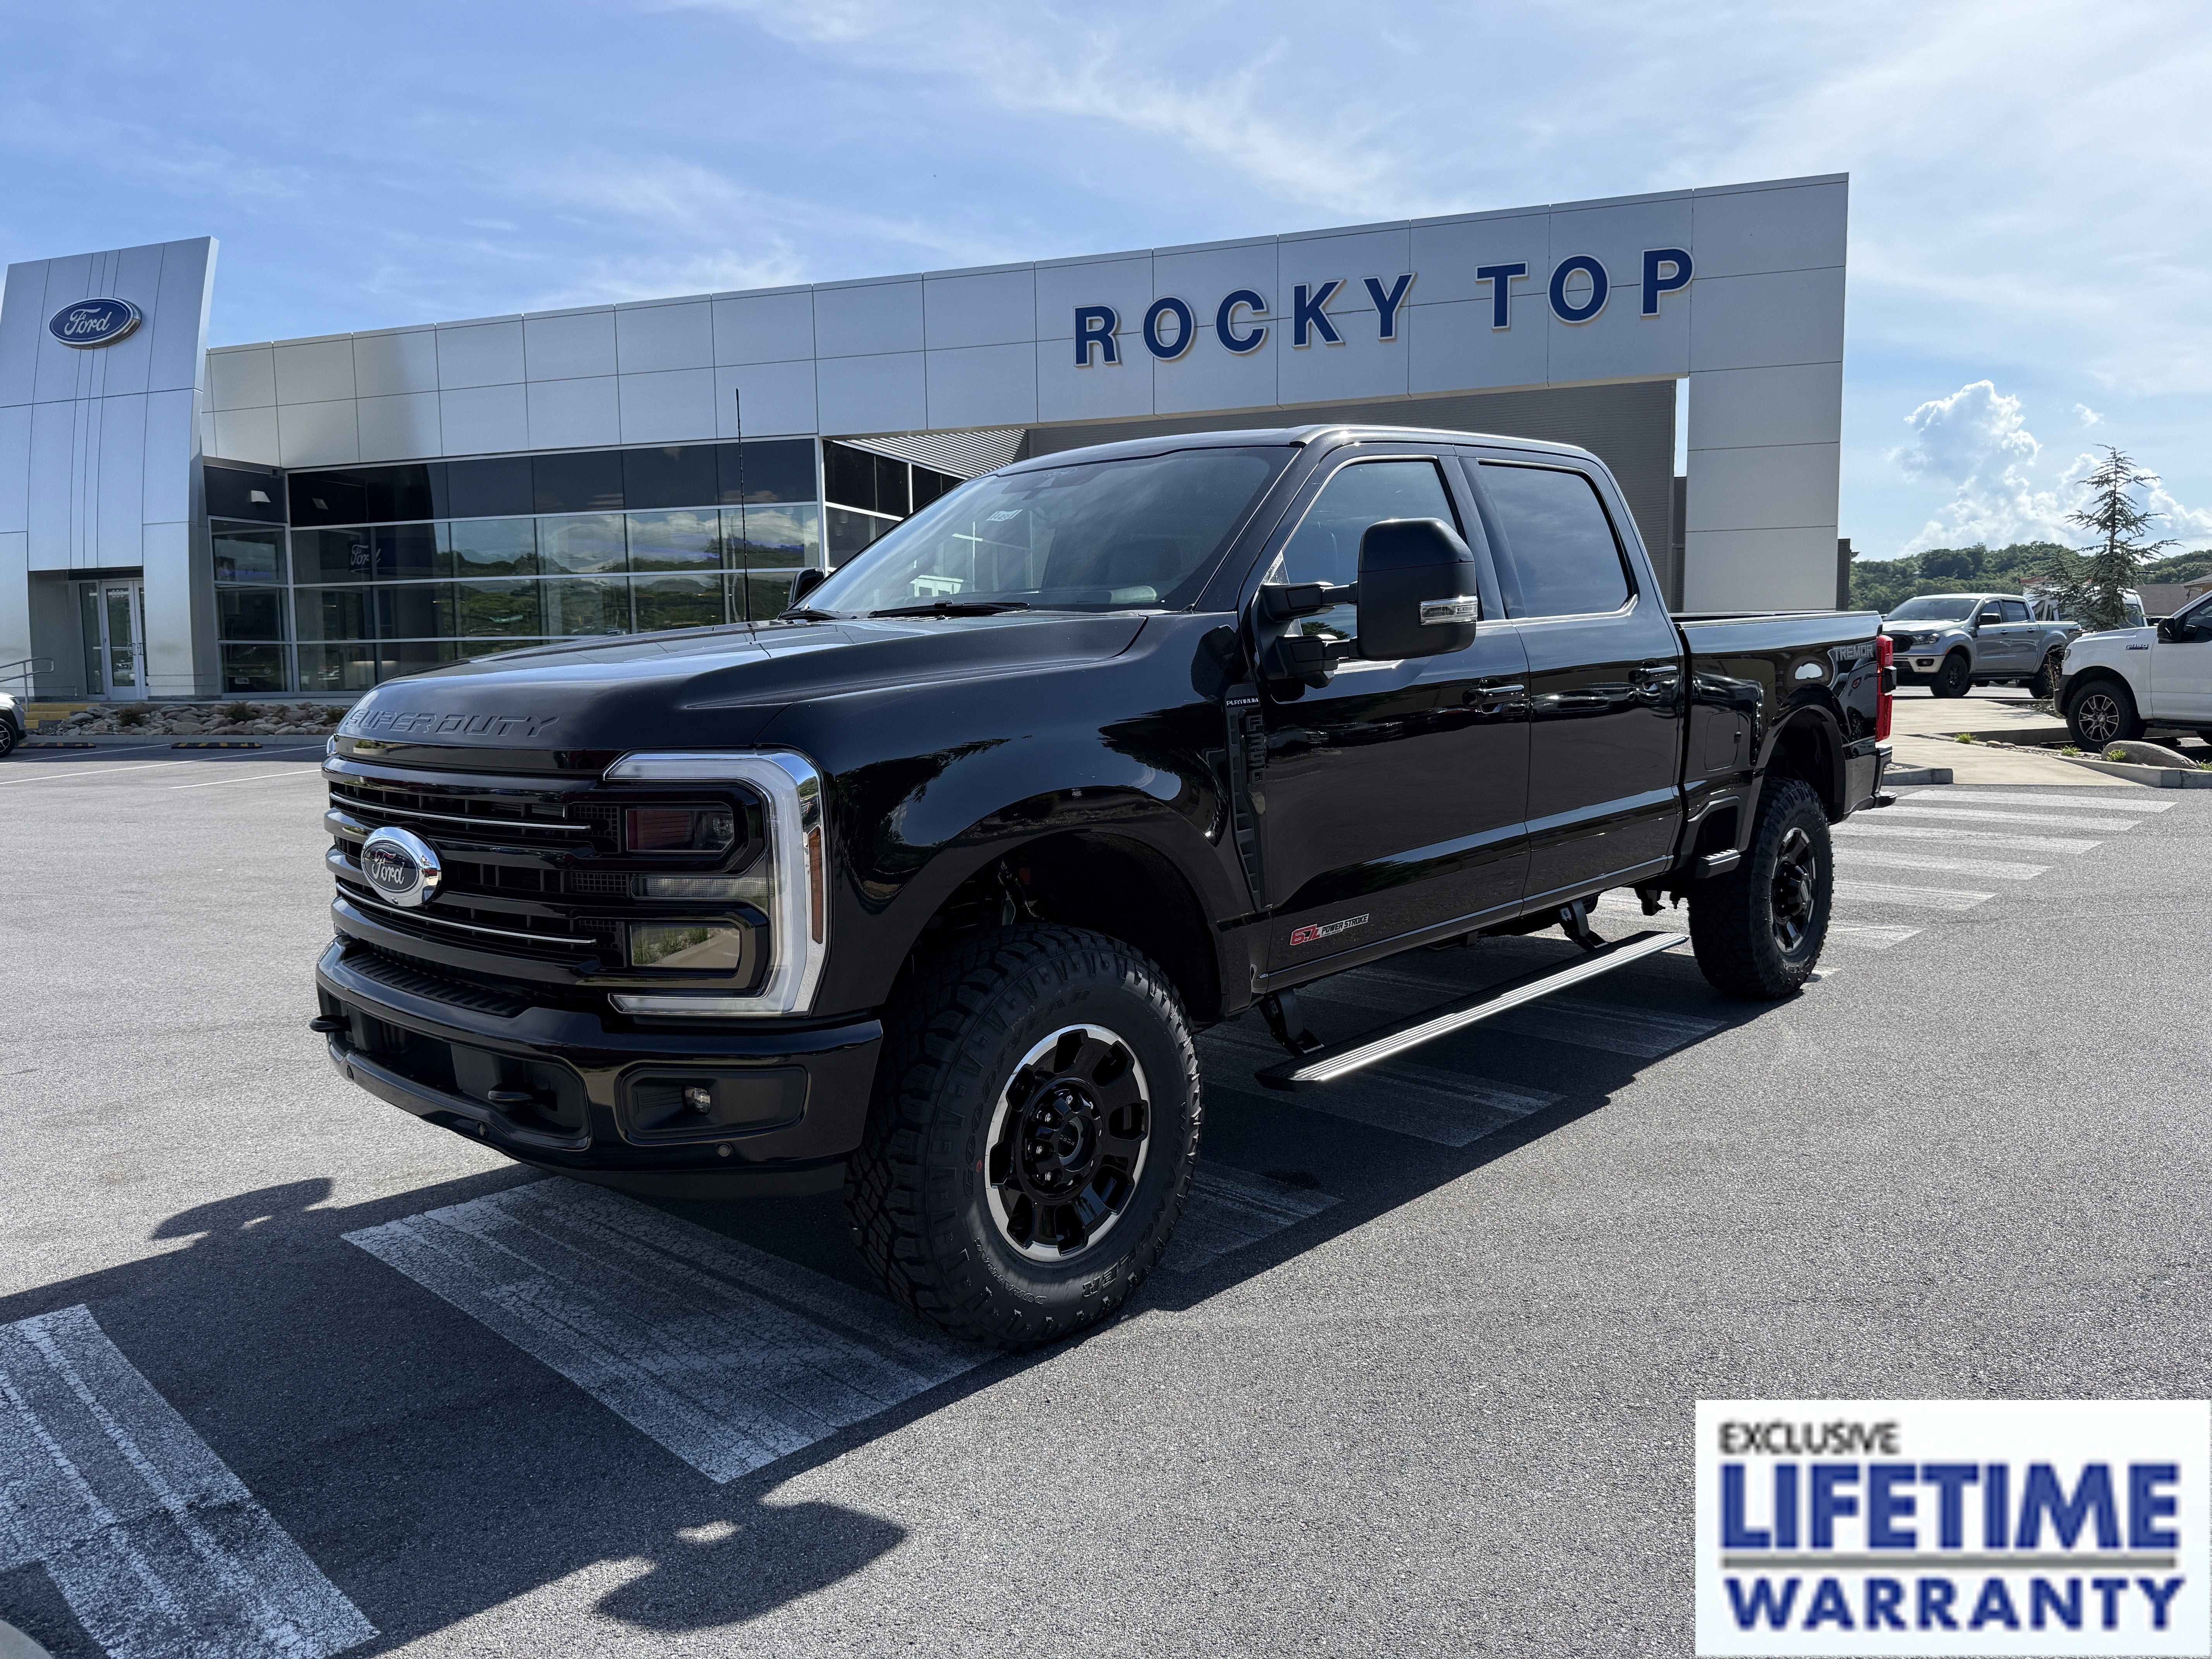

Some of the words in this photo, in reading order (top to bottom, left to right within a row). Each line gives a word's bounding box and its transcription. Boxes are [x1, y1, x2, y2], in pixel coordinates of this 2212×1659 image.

[64, 307, 112, 335] Ford
[1074, 272, 1416, 368] ROCKY
[1475, 247, 1695, 330] TOP
[1833, 645, 1874, 661] TREMOR
[345, 709, 437, 733] SUPER
[435, 713, 560, 737] DUTY
[372, 849, 405, 884] Ford
[1290, 924, 1320, 945] 6.7L
[1321, 922, 1343, 934] POWER
[1344, 915, 1368, 928] STROKE
[963, 989, 1091, 1198] GOODYEAR
[1083, 1102, 1186, 1297] WRANGLER
[974, 1237, 1047, 1304] DURATRAC
